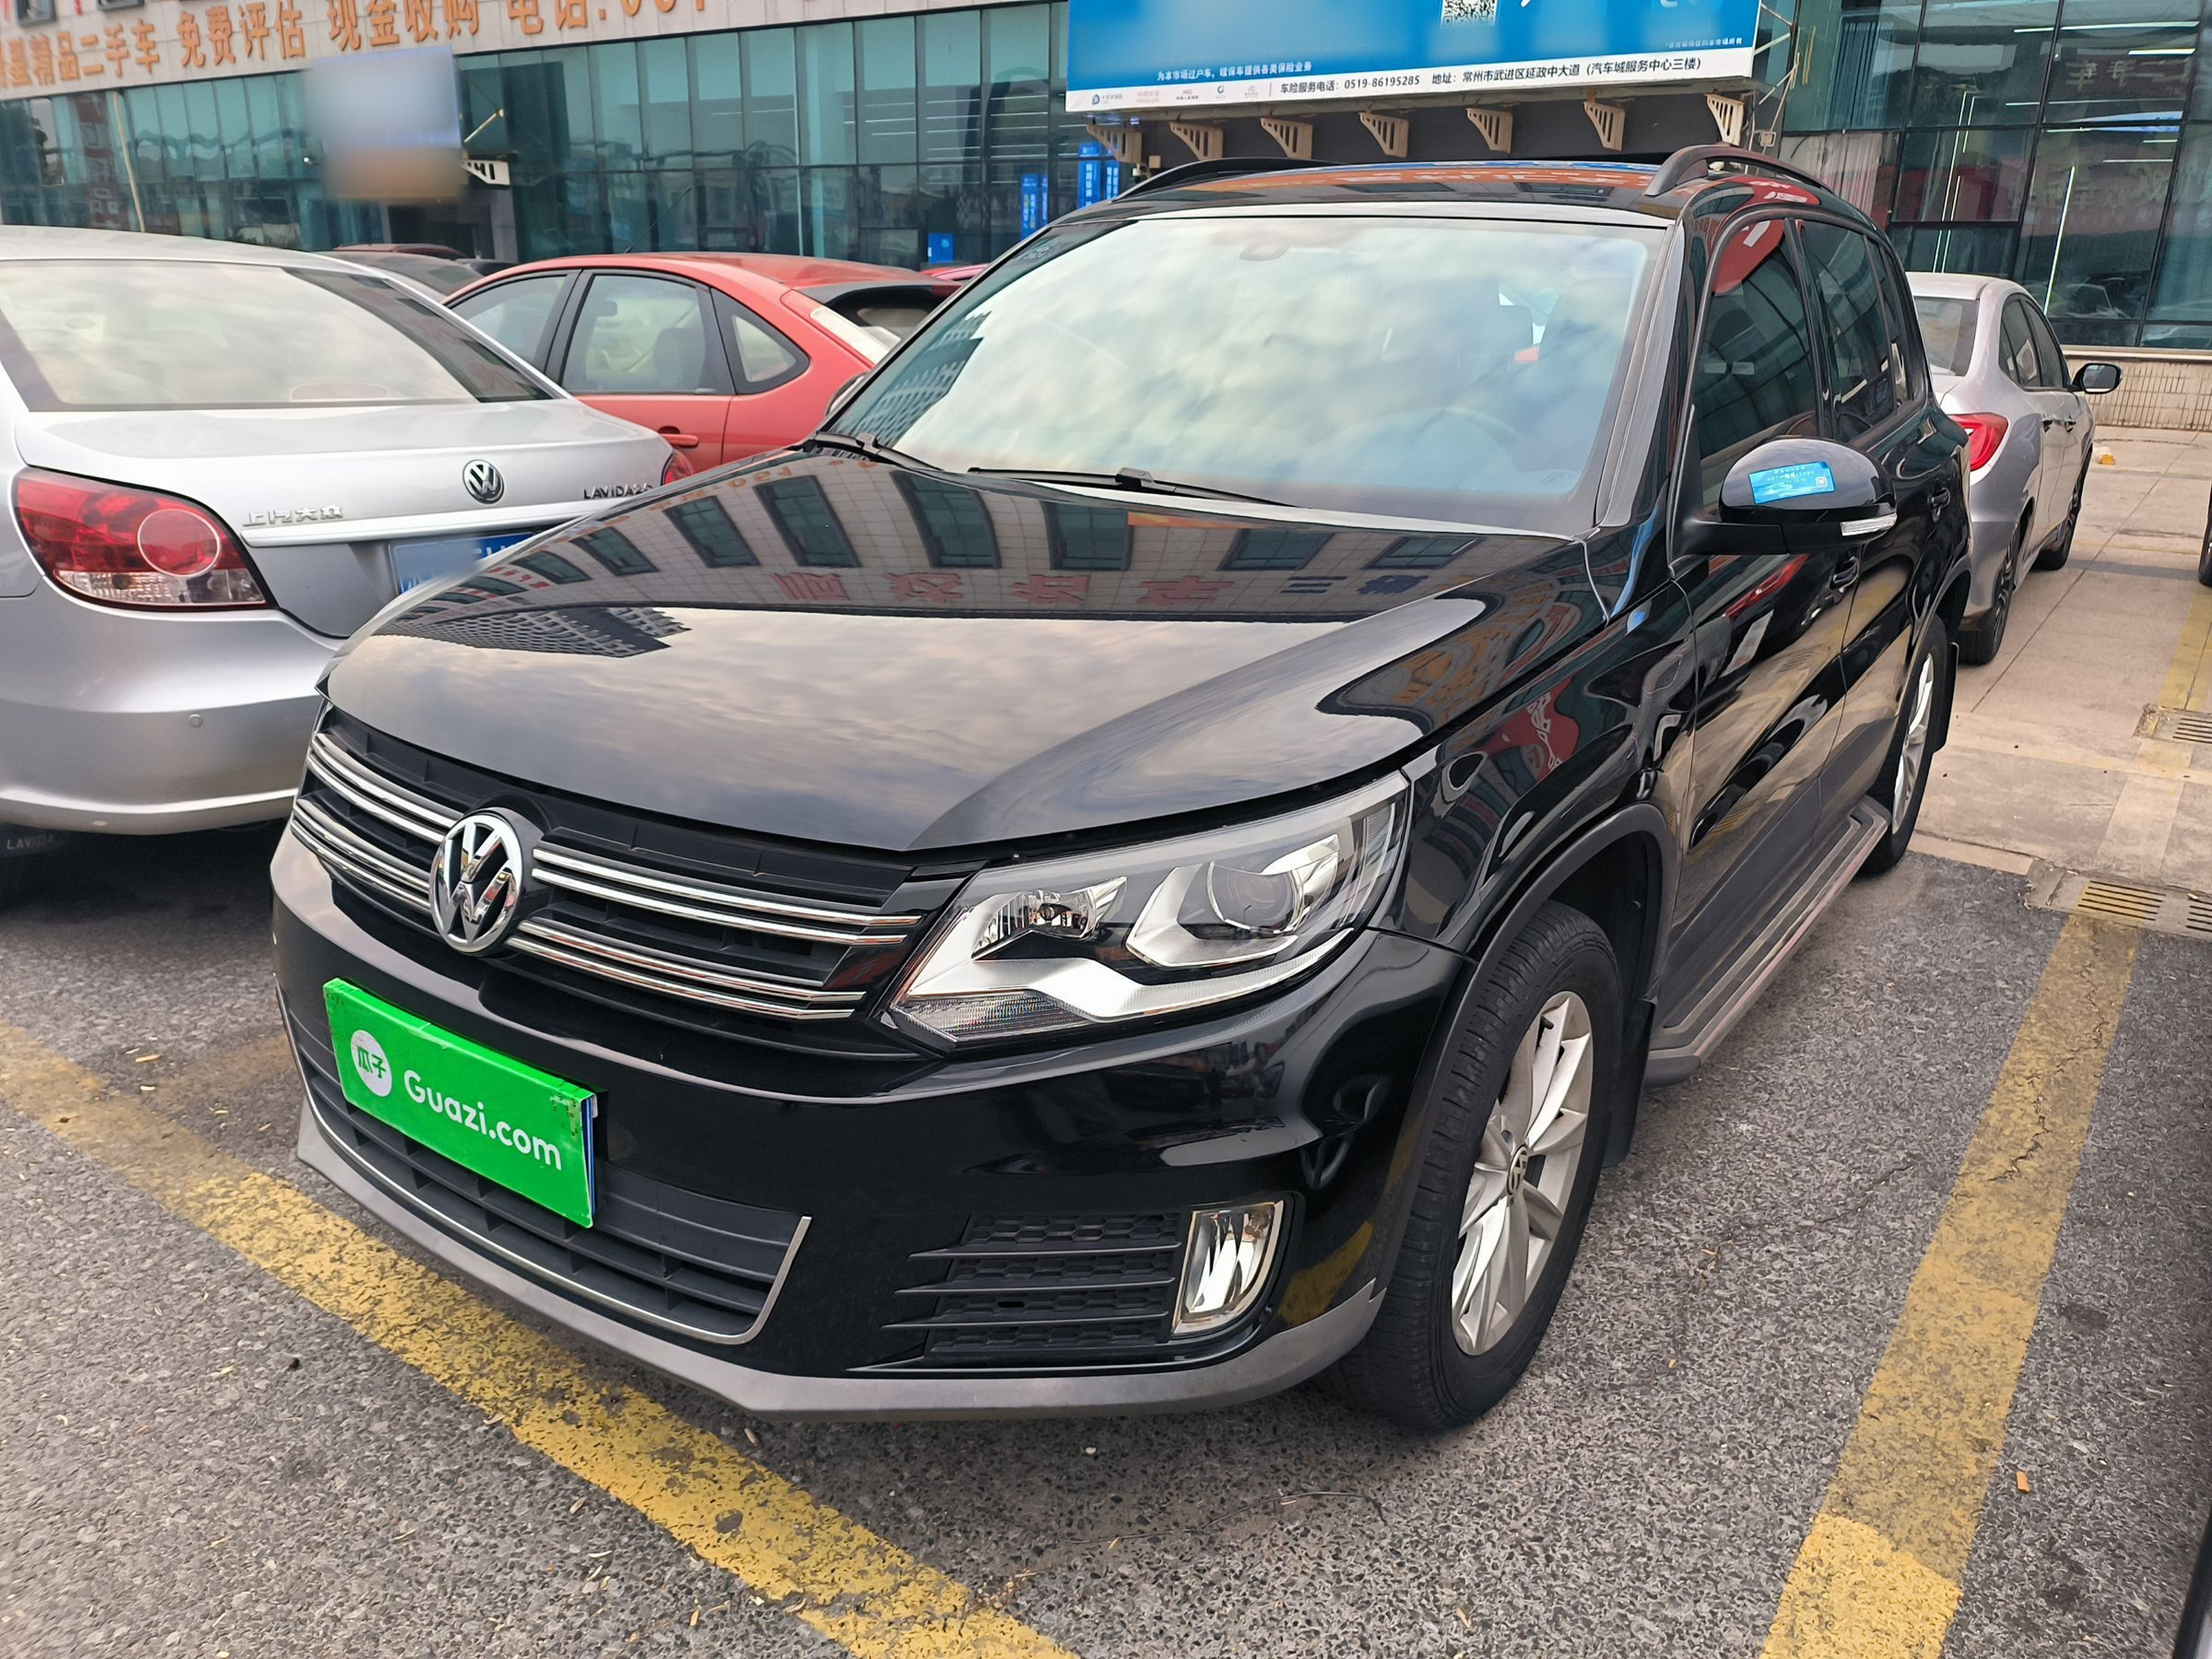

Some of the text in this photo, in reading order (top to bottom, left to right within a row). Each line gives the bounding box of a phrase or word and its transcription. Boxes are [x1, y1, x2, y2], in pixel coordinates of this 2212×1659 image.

[0, 18, 160, 89] 星精品二手车
[177, 1, 306, 67] 免费评估
[327, 0, 479, 50] 现金收购
[584, 483, 634, 499] LAVIDA
[357, 1046, 387, 1080] 瓜子
[404, 1069, 562, 1171] Guazi.com
